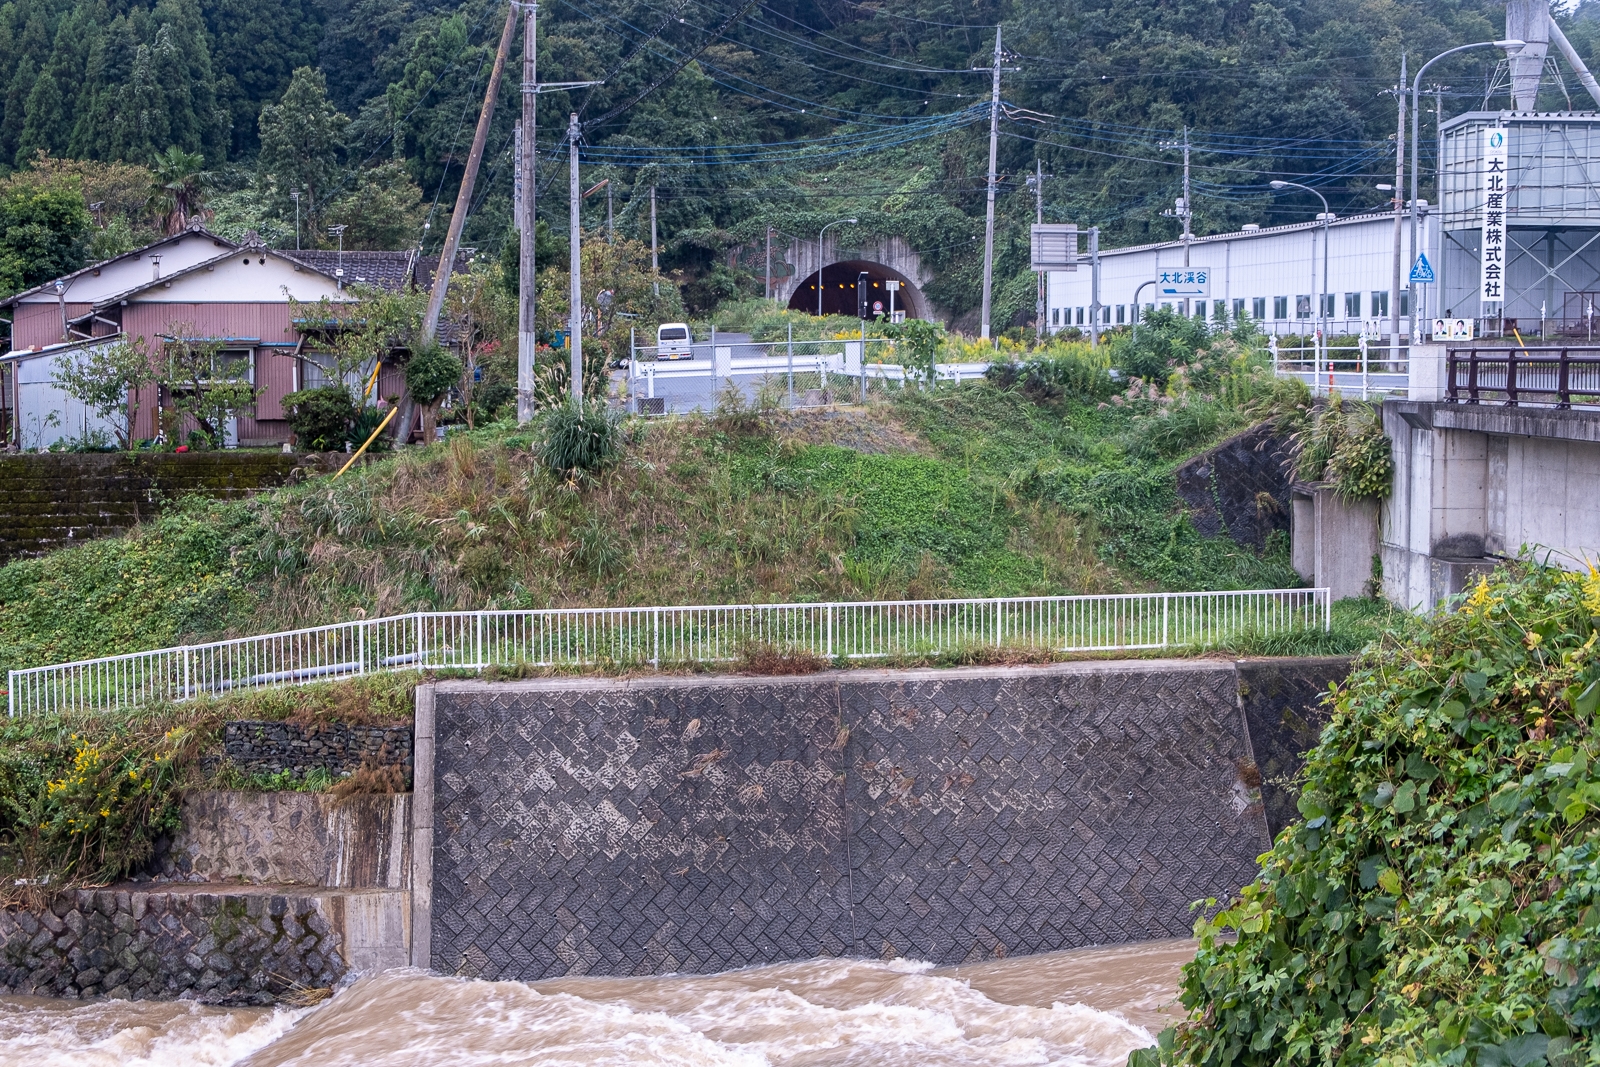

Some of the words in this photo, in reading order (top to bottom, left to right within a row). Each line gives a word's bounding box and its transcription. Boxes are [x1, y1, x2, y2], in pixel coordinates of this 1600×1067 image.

[1485, 158, 1504, 297] 大北産業株式会社
[1160, 271, 1207, 284] 大北渓谷
